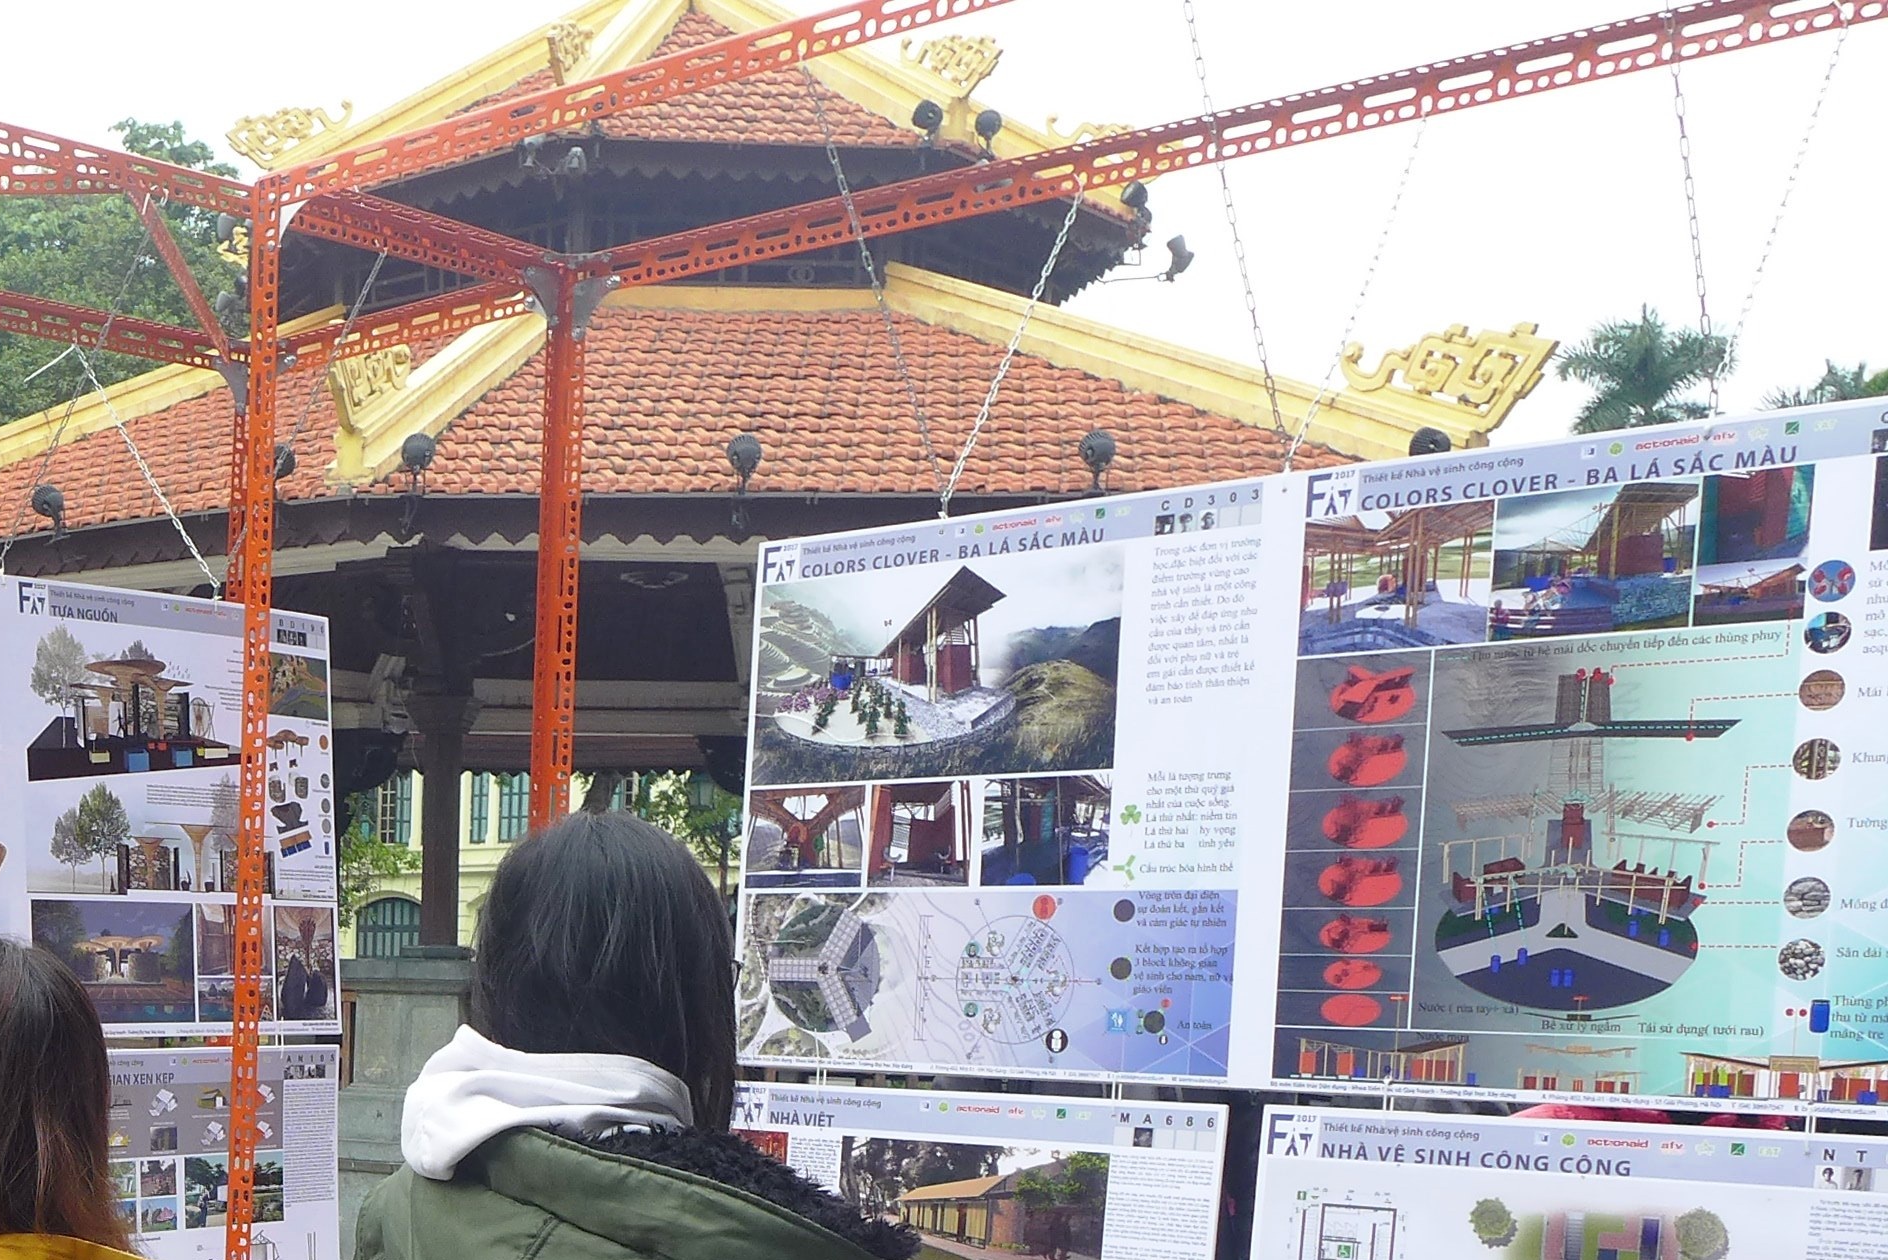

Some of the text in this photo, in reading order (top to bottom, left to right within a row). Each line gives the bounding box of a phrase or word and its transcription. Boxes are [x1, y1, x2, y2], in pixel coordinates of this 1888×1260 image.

[1335, 470, 1356, 480] 2017
[1361, 446, 1798, 512] COLORS CLOVER BA LÁ SẮC MÀU
[1363, 473, 1389, 484] Thiết
[1405, 470, 1426, 480] Nhà
[1443, 464, 1465, 475] sinh
[1468, 461, 1494, 473] công
[1497, 457, 1524, 470] cộng
[1161, 500, 1170, 511] C
[1184, 497, 1194, 509] D
[1208, 494, 1216, 505] 3
[801, 527, 1105, 579] COLORS CLOVER BA LÁ SẮC MÀU
[133, 1072, 154, 1085] XEN
[769, 1110, 835, 1131] NHÀ VIỆT
[1119, 1112, 1215, 1128] M A 6 8 6
[1296, 1114, 1317, 1123] 2017
[1323, 1122, 1347, 1133] Thiết
[1365, 1124, 1384, 1135] Nhà
[1401, 1126, 1423, 1137] sinh
[1426, 1127, 1451, 1140] công
[1453, 1129, 1480, 1142] cộng
[1587, 1137, 1649, 1149] actionaid
[1321, 1141, 1632, 1179] NHÀ VỆ SINH CÔNG CỘNG
[1823, 1148, 1869, 1163] N T
